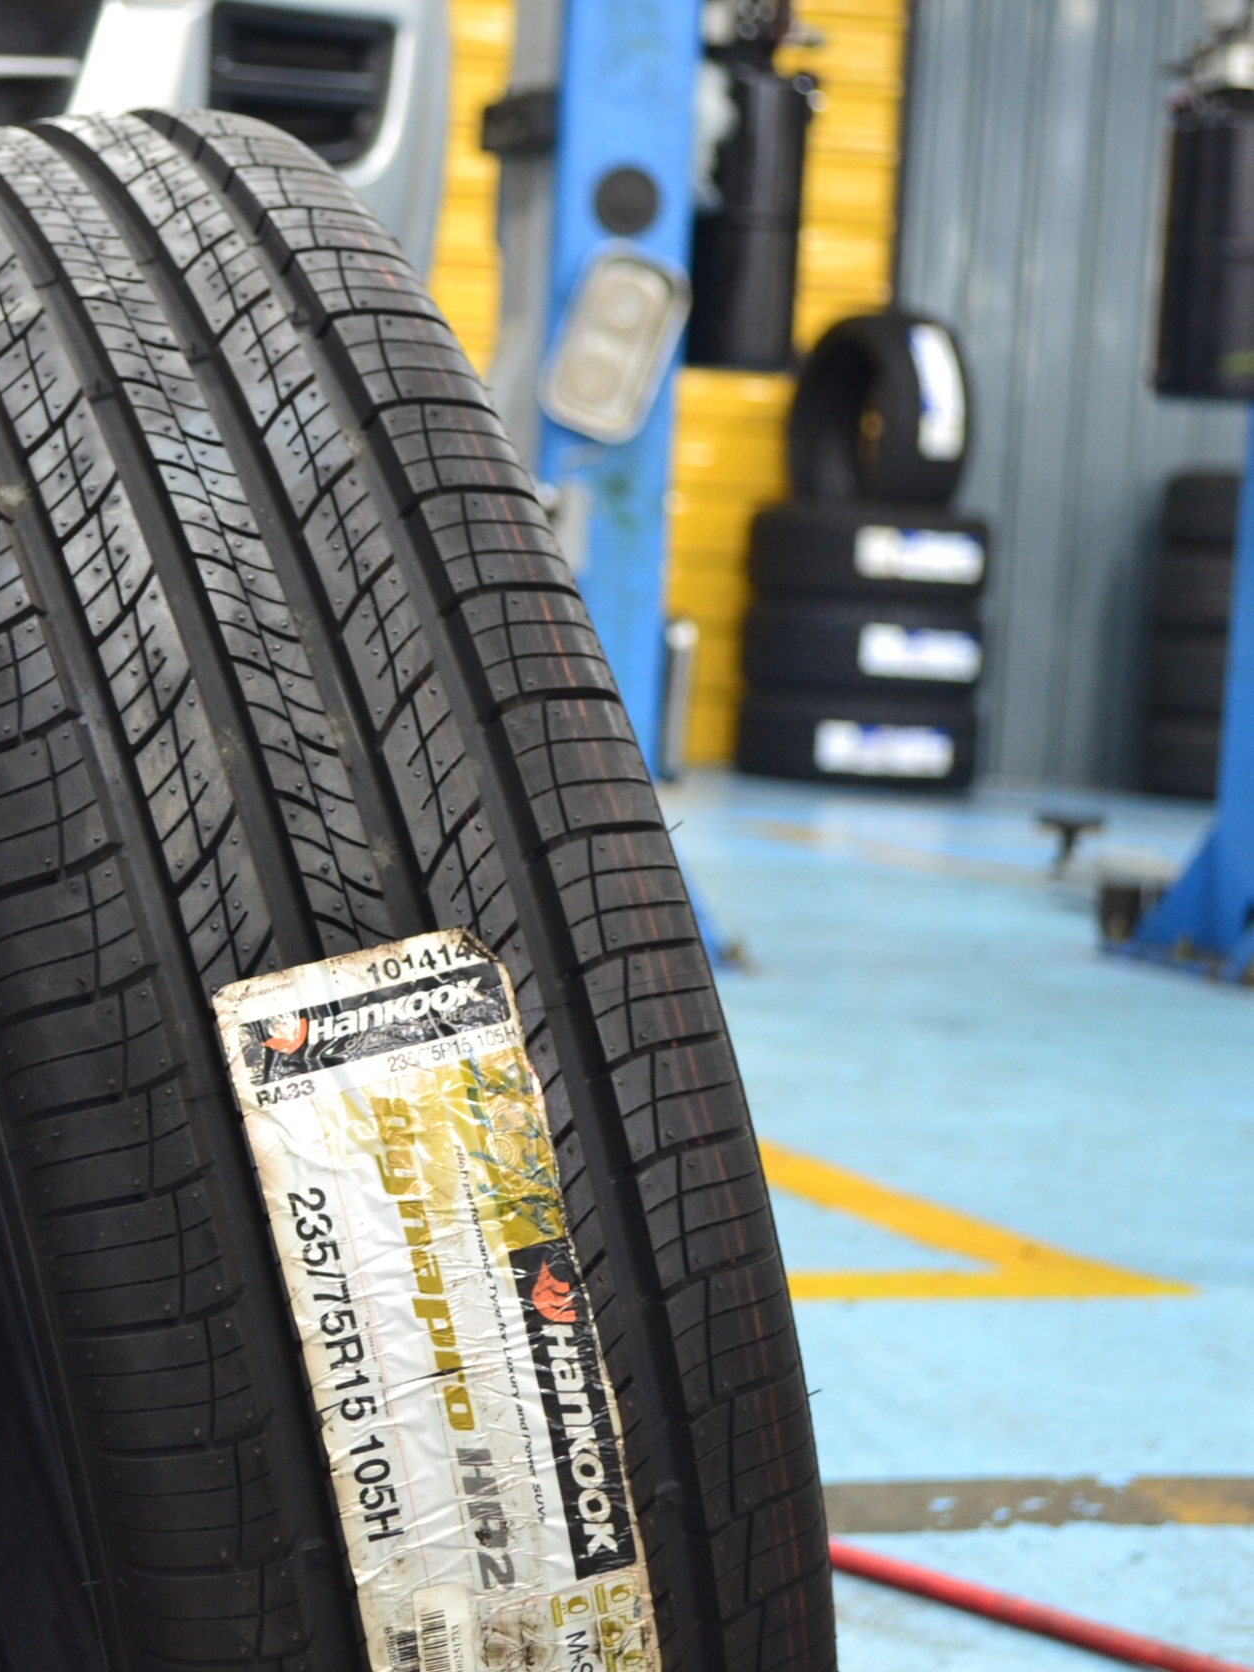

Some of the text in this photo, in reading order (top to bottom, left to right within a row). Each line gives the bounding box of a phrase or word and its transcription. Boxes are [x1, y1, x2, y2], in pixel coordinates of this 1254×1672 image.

[366, 943, 485, 986] 101414
[476, 1024, 517, 1048] 105H
[287, 1187, 404, 1543] 235/75R15 105H
[462, 1183, 493, 1280] performance
[497, 1321, 509, 1343] for
[503, 1347, 521, 1400] Luxury
[516, 1403, 529, 1431] and
